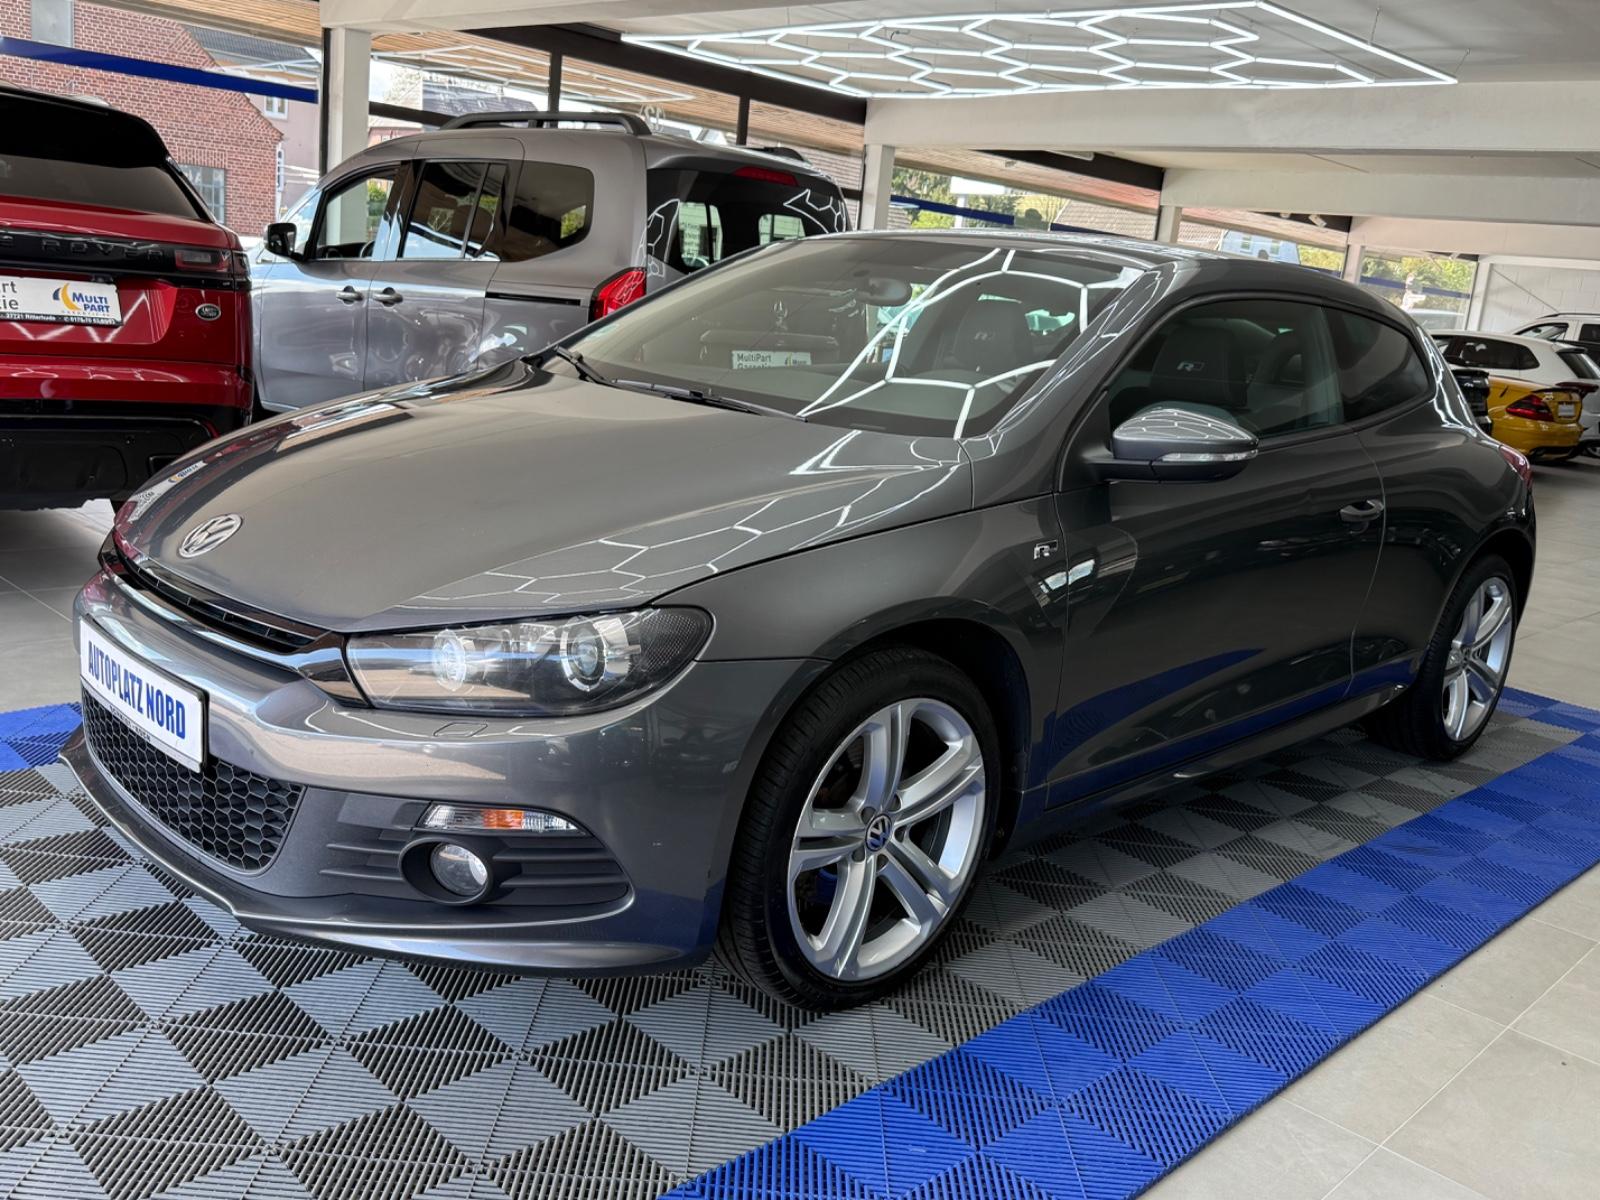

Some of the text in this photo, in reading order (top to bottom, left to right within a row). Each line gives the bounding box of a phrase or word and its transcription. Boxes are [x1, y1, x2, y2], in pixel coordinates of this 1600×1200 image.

[72, 292, 108, 304] MULTI
[84, 304, 110, 313] PART
[737, 353, 772, 362] MultiPart
[88, 640, 186, 740] AUTOPLATZ NORD
